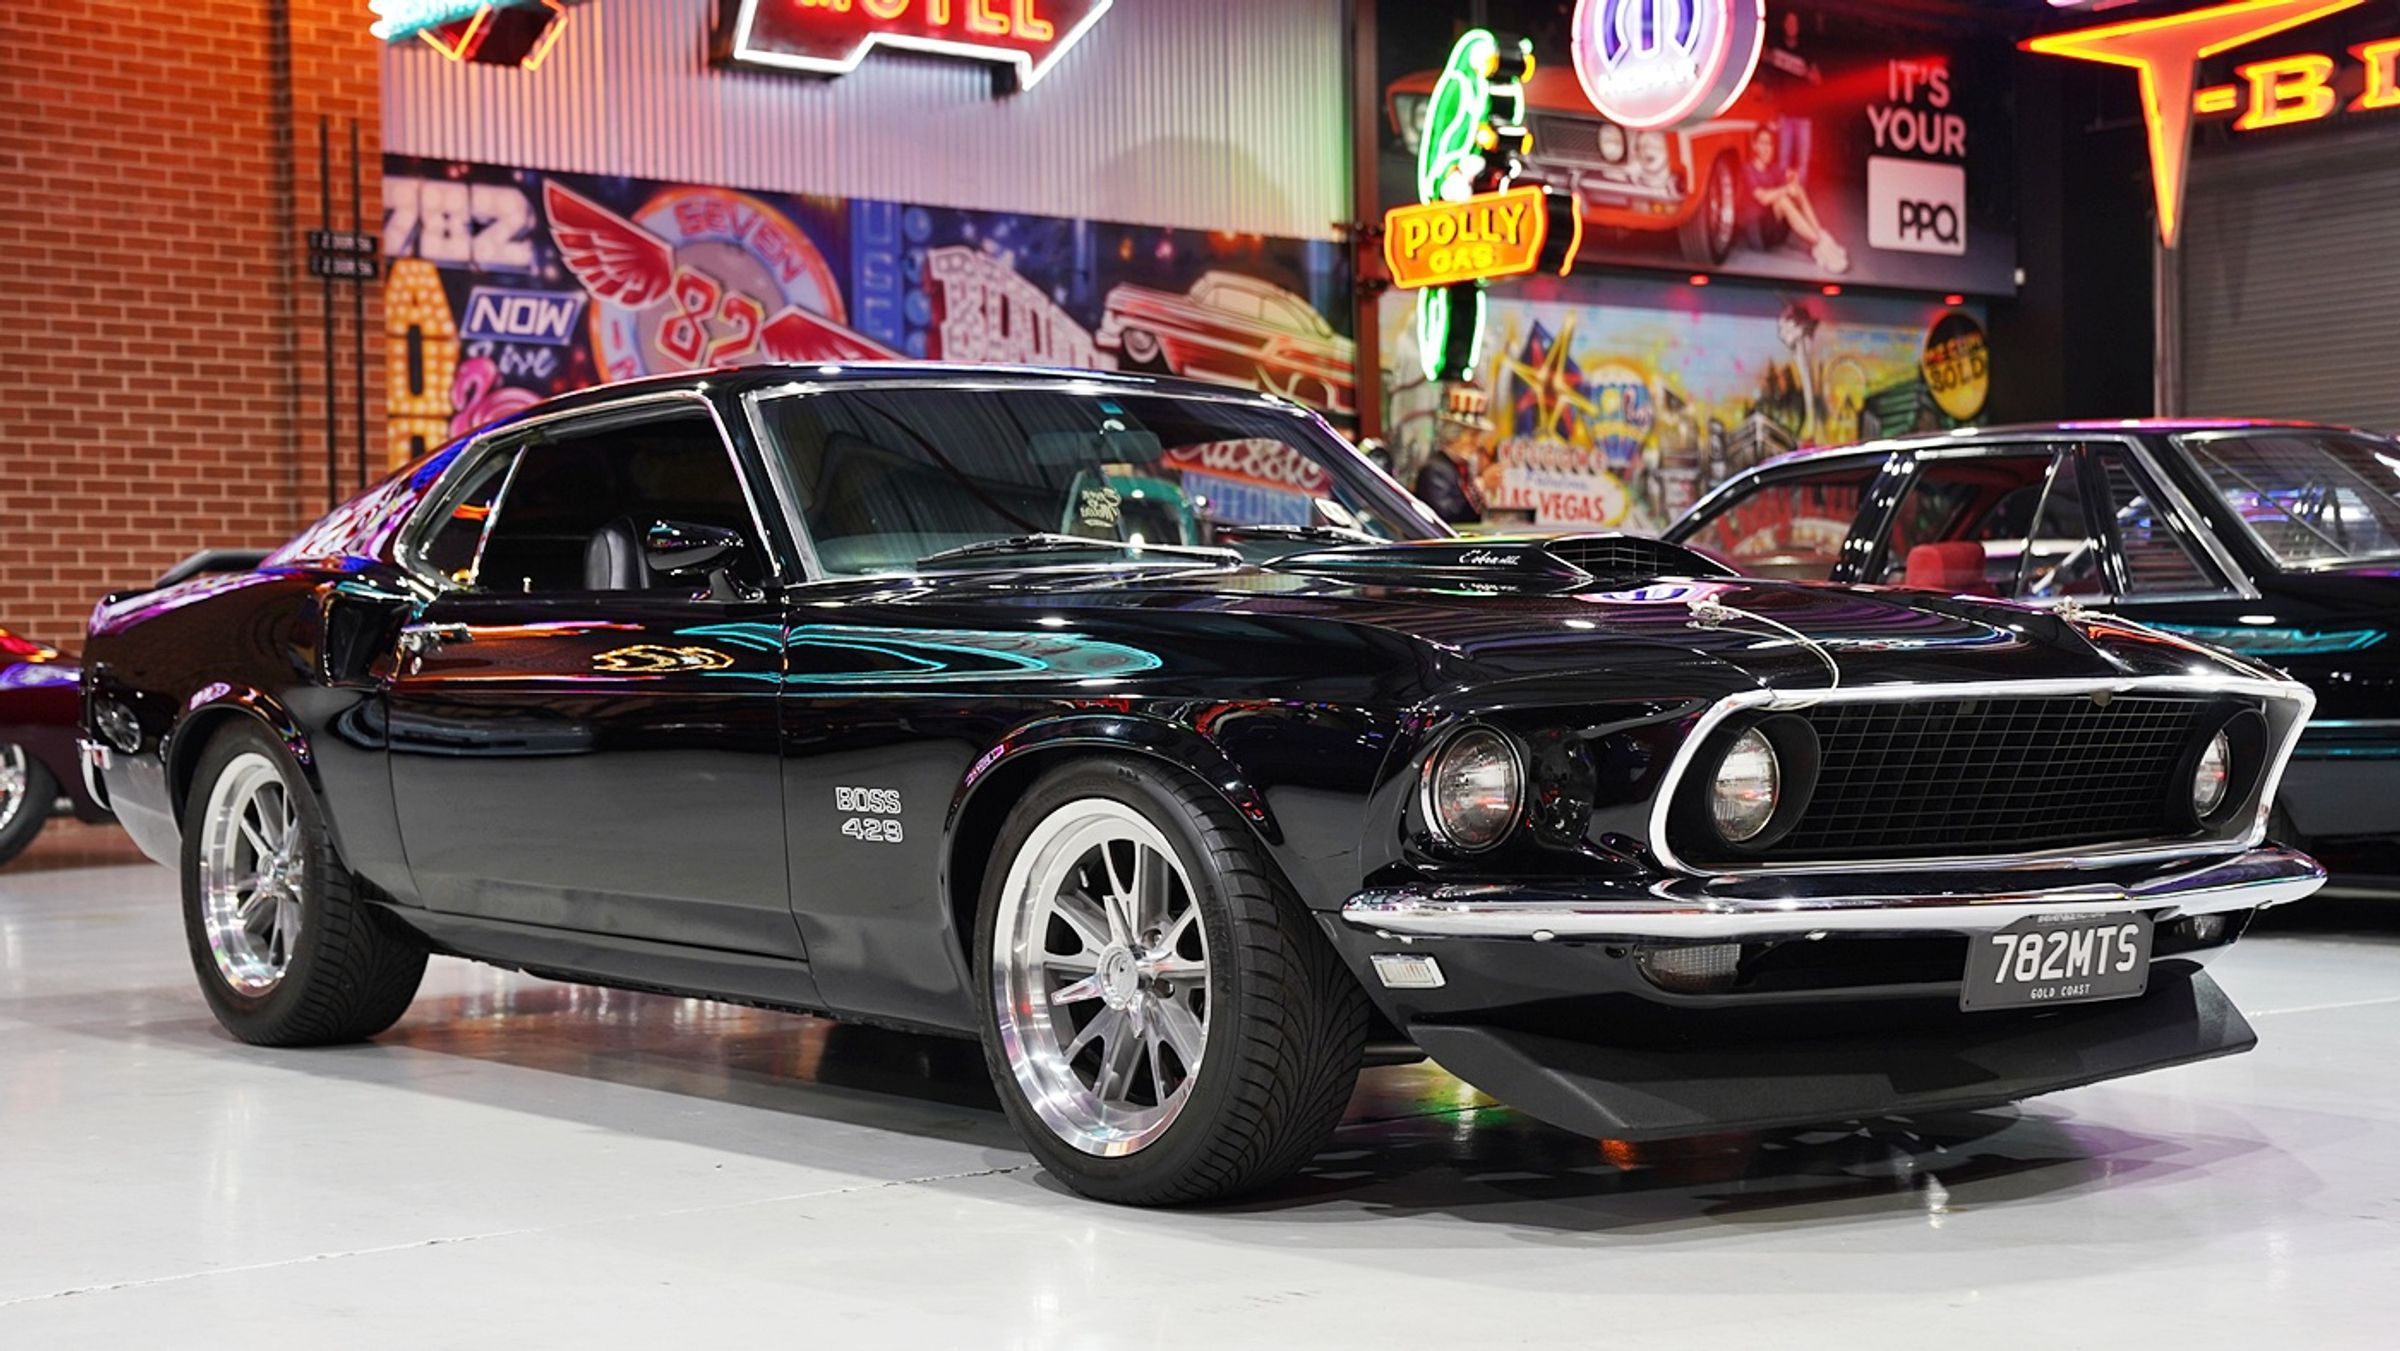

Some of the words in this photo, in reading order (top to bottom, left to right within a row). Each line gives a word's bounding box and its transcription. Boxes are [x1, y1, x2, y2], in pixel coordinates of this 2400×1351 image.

[1889, 60, 1949, 108] IT'S
[1867, 104, 1966, 157] YOUR
[383, 176, 534, 268] 782
[673, 202, 804, 283] SEVEN
[1402, 203, 1526, 258] POLLY
[1900, 201, 1959, 244] PPQ
[1429, 243, 1494, 273] GAS
[470, 296, 574, 337] NOW
[656, 265, 765, 368] 82
[1930, 356, 1984, 392] SOLD
[1538, 491, 1605, 523] VEGAS
[835, 787, 901, 814] BOSS
[842, 818, 903, 843] 429
[1992, 924, 2139, 983] 782MTS
[2031, 987, 2055, 999] GOLD
[2061, 984, 2091, 996] COAST
